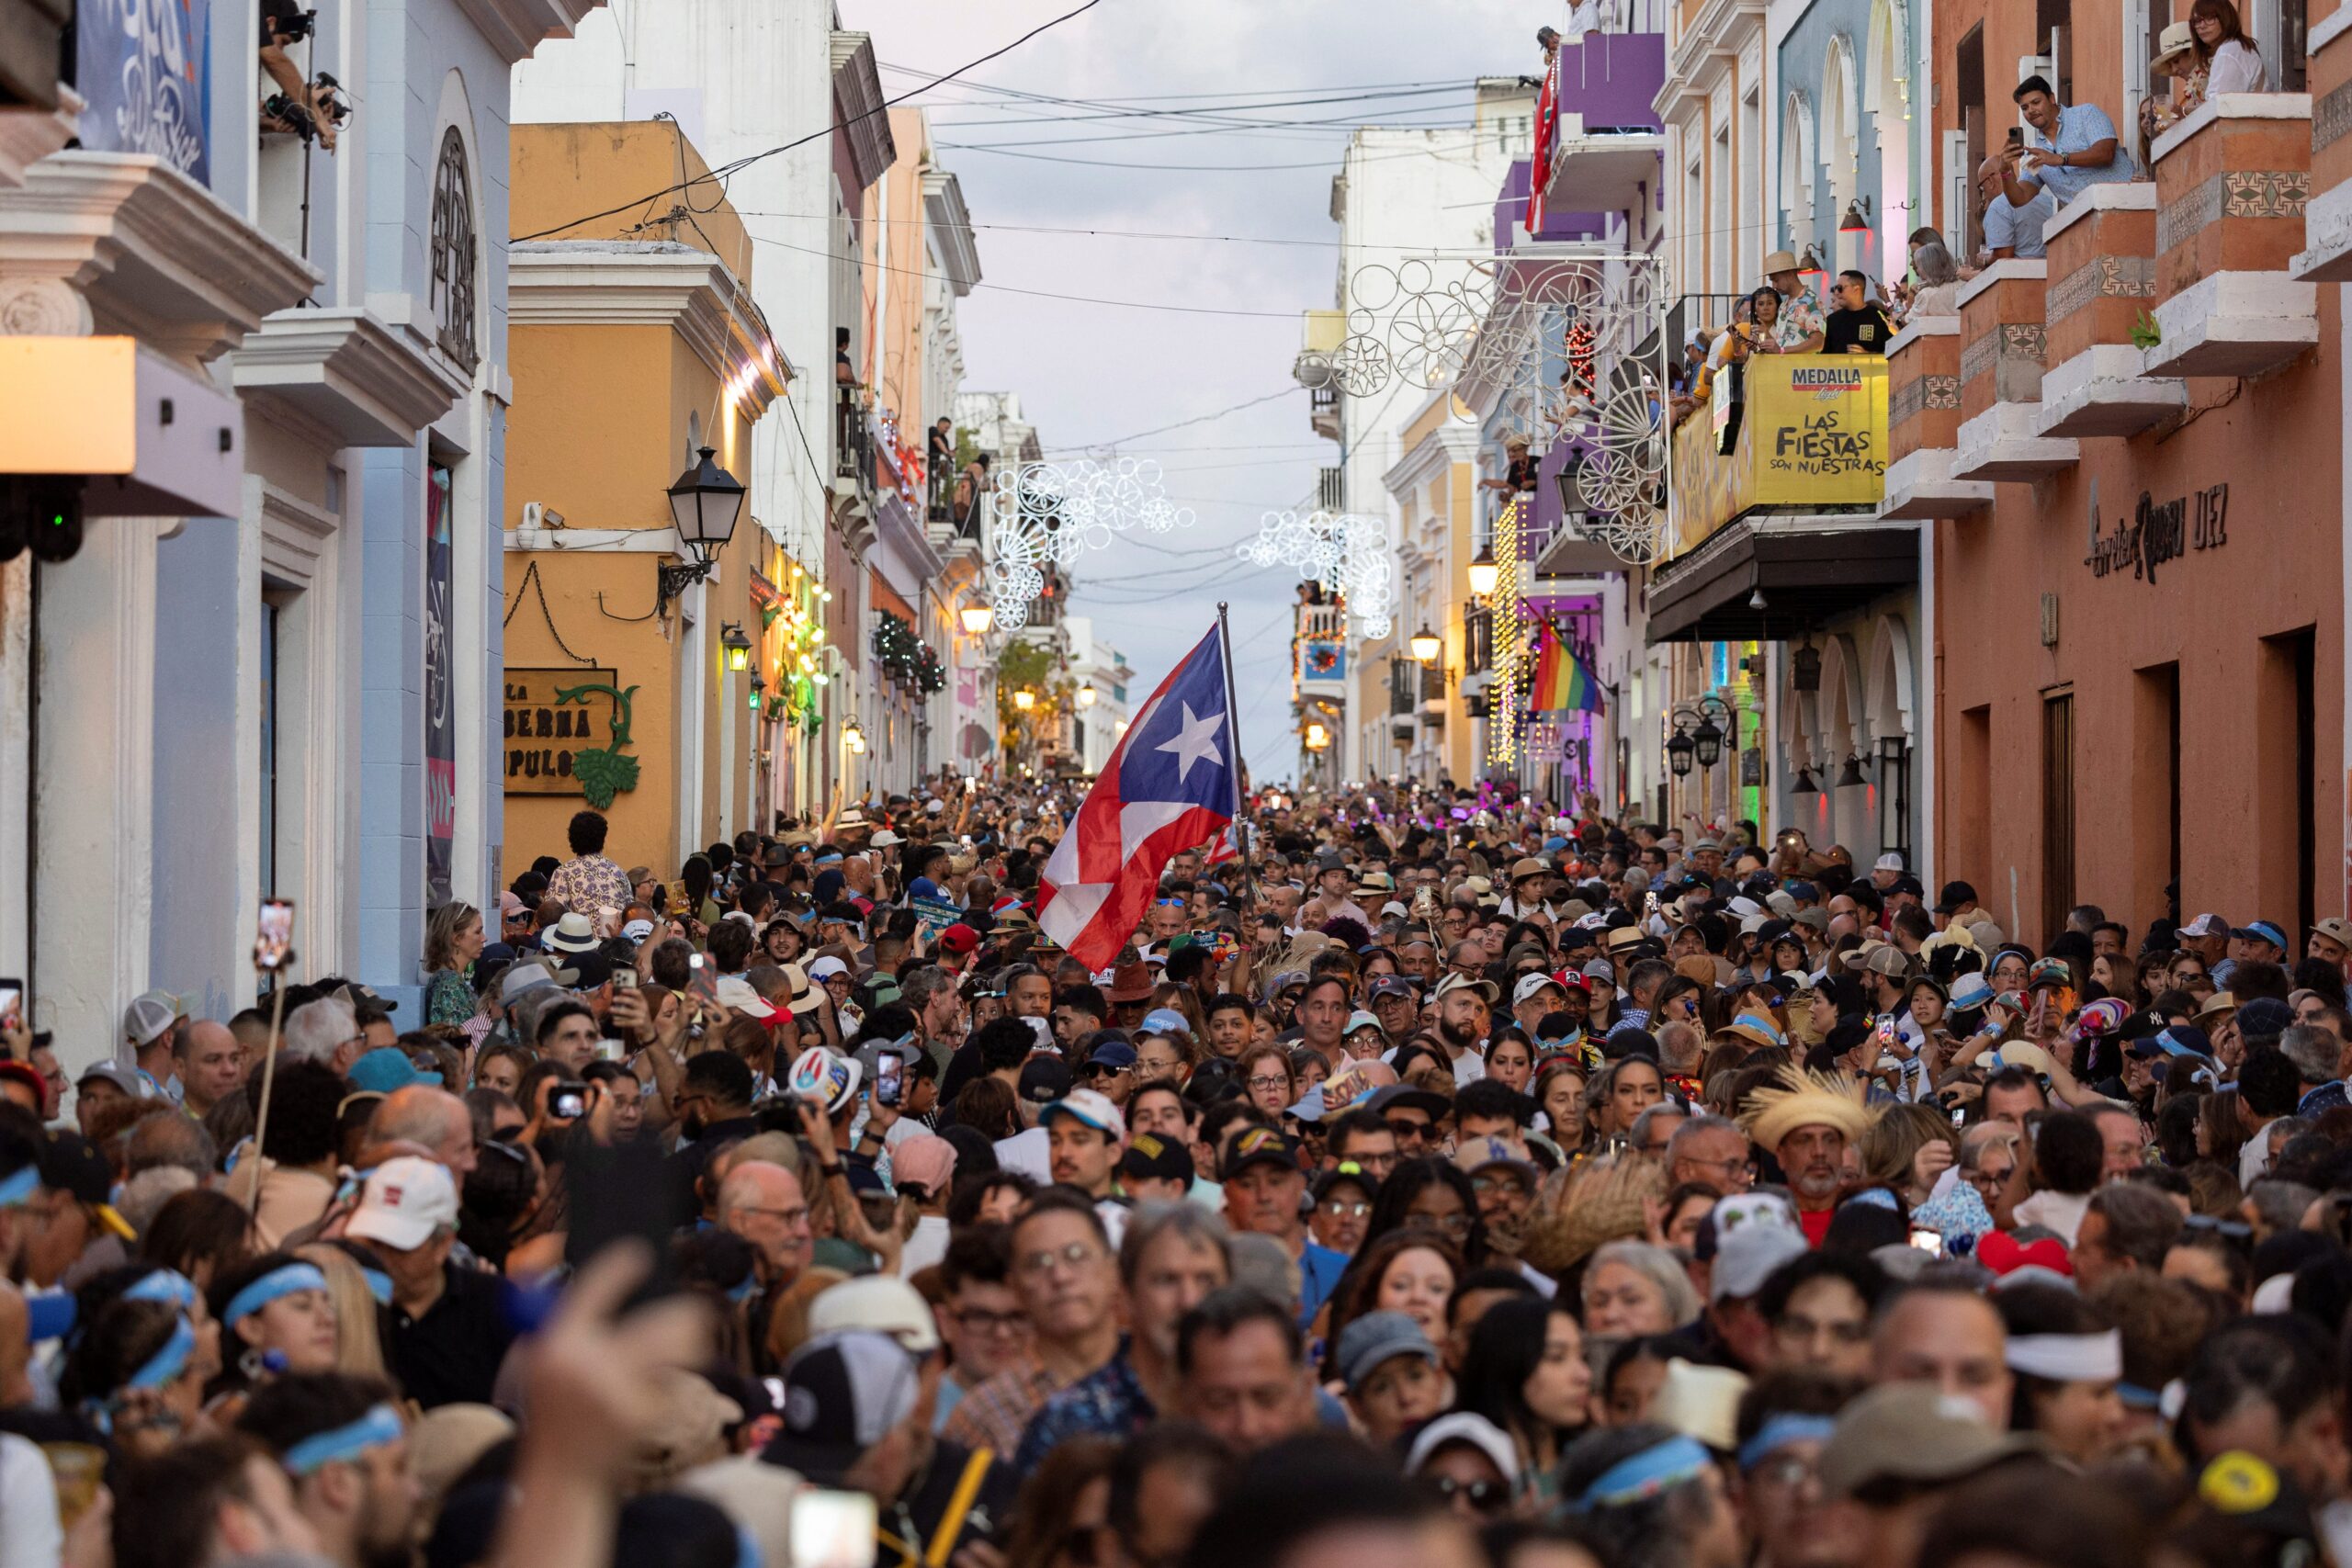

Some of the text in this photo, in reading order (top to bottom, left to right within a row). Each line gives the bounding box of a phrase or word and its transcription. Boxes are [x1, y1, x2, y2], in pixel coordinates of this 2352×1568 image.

[1792, 368, 1862, 384] MEDALLA
[1813, 387, 1845, 400] Light
[1805, 411, 1838, 432] LAS
[1776, 426, 1871, 458] FIESTAS
[1770, 458, 1885, 477] SON NUESTRAS
[505, 682, 527, 700] LA
[503, 748, 573, 778] PULO
[1148, 1018, 1176, 1031] wapa
[2149, 1011, 2164, 1025] NY
